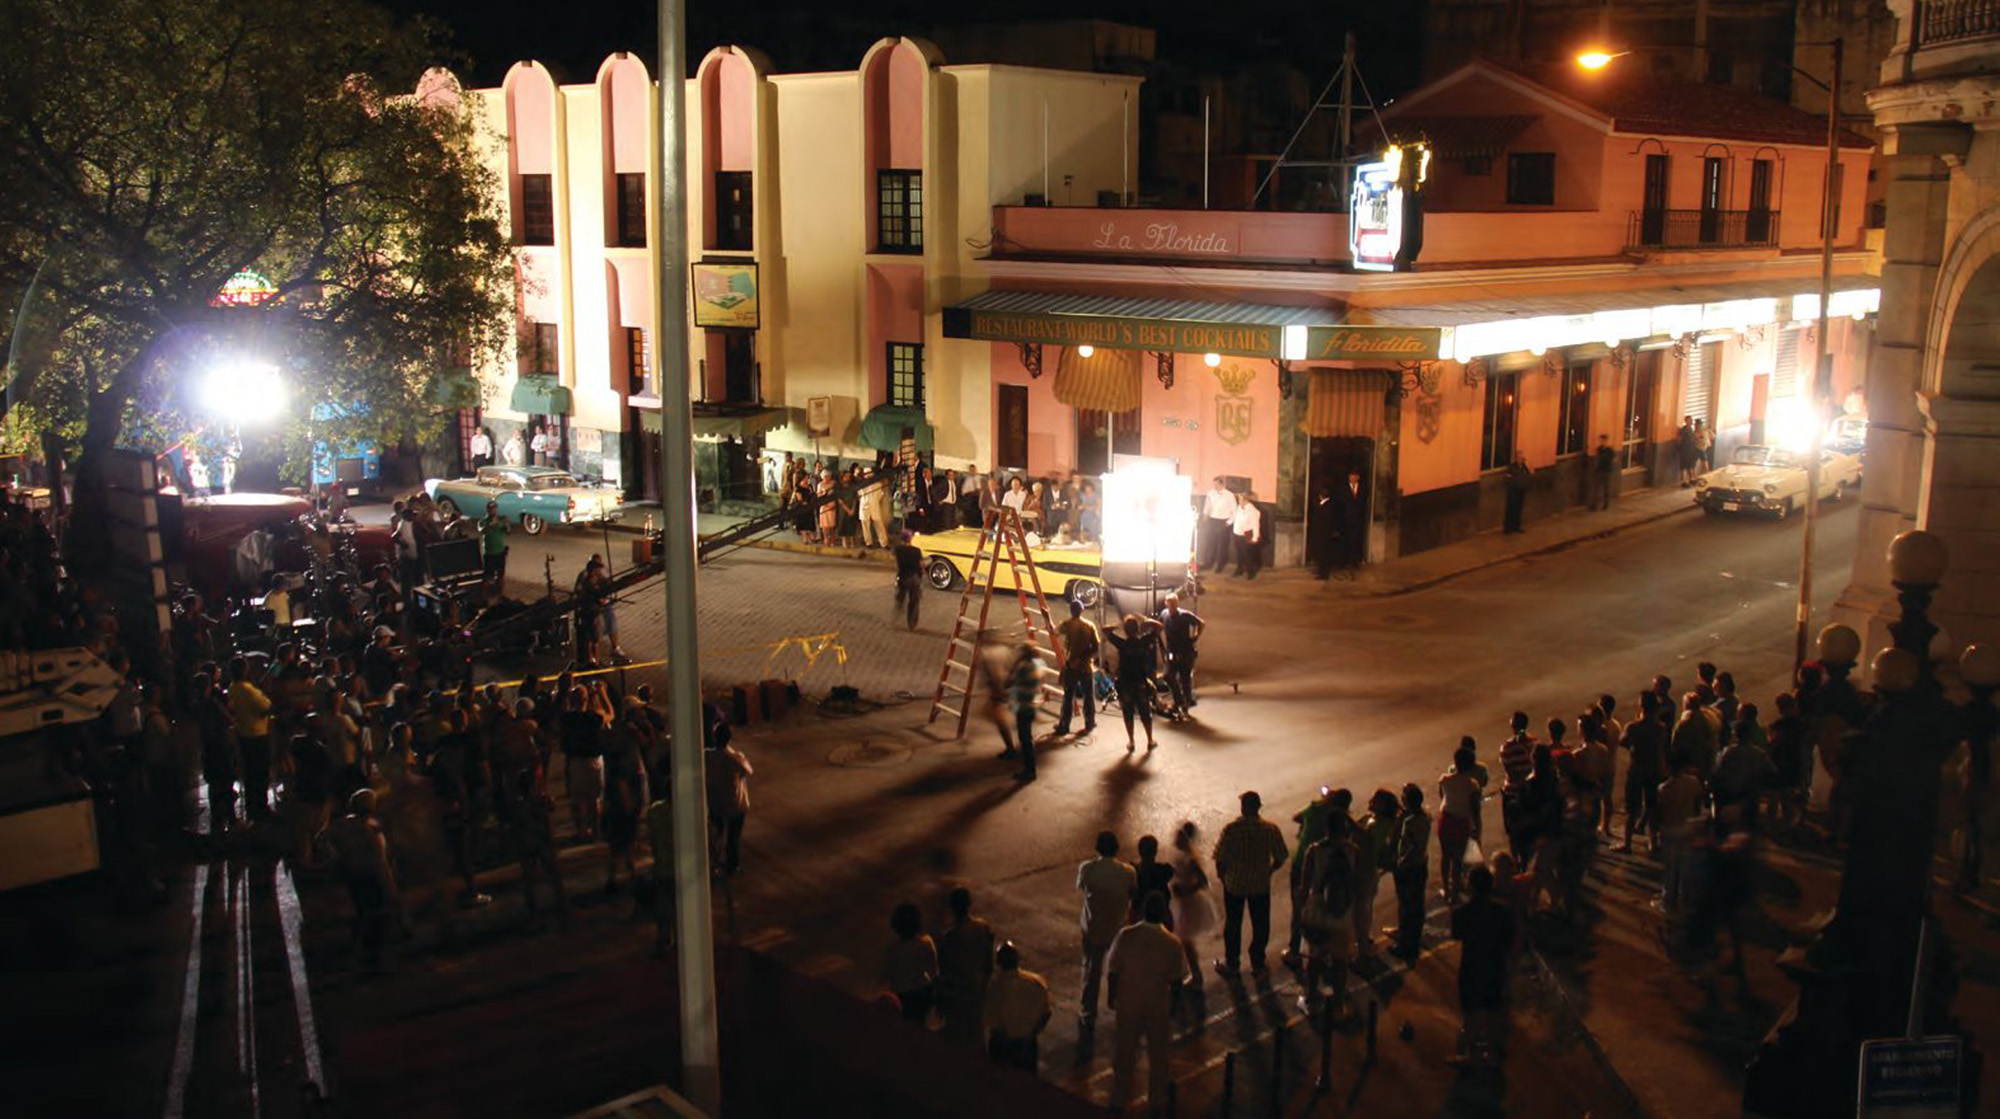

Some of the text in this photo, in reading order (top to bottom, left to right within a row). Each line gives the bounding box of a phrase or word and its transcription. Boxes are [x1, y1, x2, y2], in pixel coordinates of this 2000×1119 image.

[1093, 222, 1230, 252] La Florida
[1139, 324, 1176, 346] BEST
[1182, 327, 1269, 350] COCKTAILS
